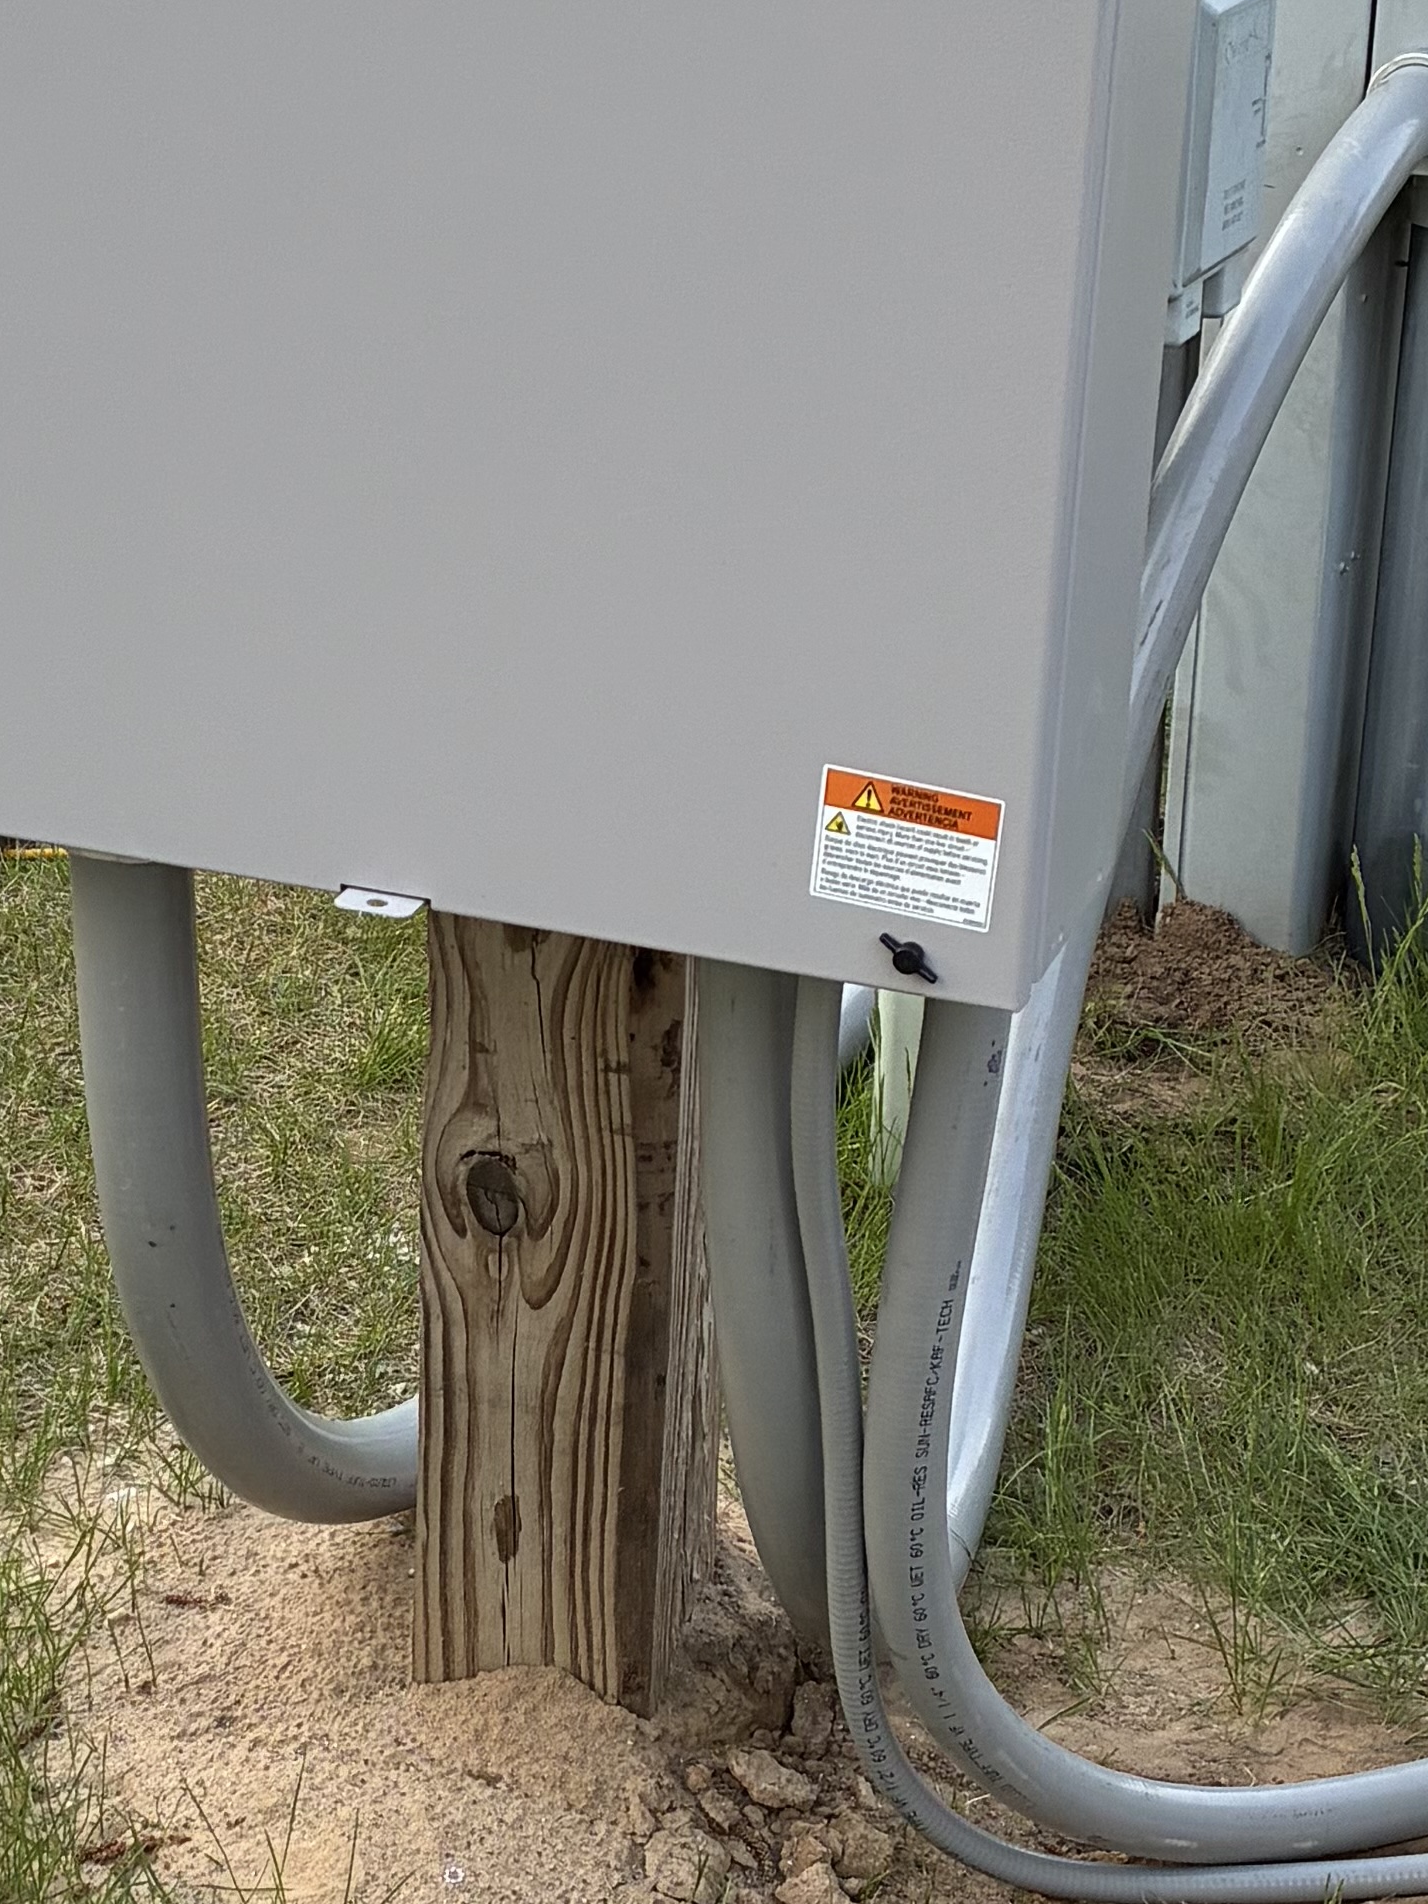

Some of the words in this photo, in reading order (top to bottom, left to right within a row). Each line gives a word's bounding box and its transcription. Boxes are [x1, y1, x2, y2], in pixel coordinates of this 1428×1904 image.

[891, 786, 939, 803] WARNING
[887, 807, 959, 829] ADVERTENCIA
[889, 796, 972, 821] AVERTISSEMENT
